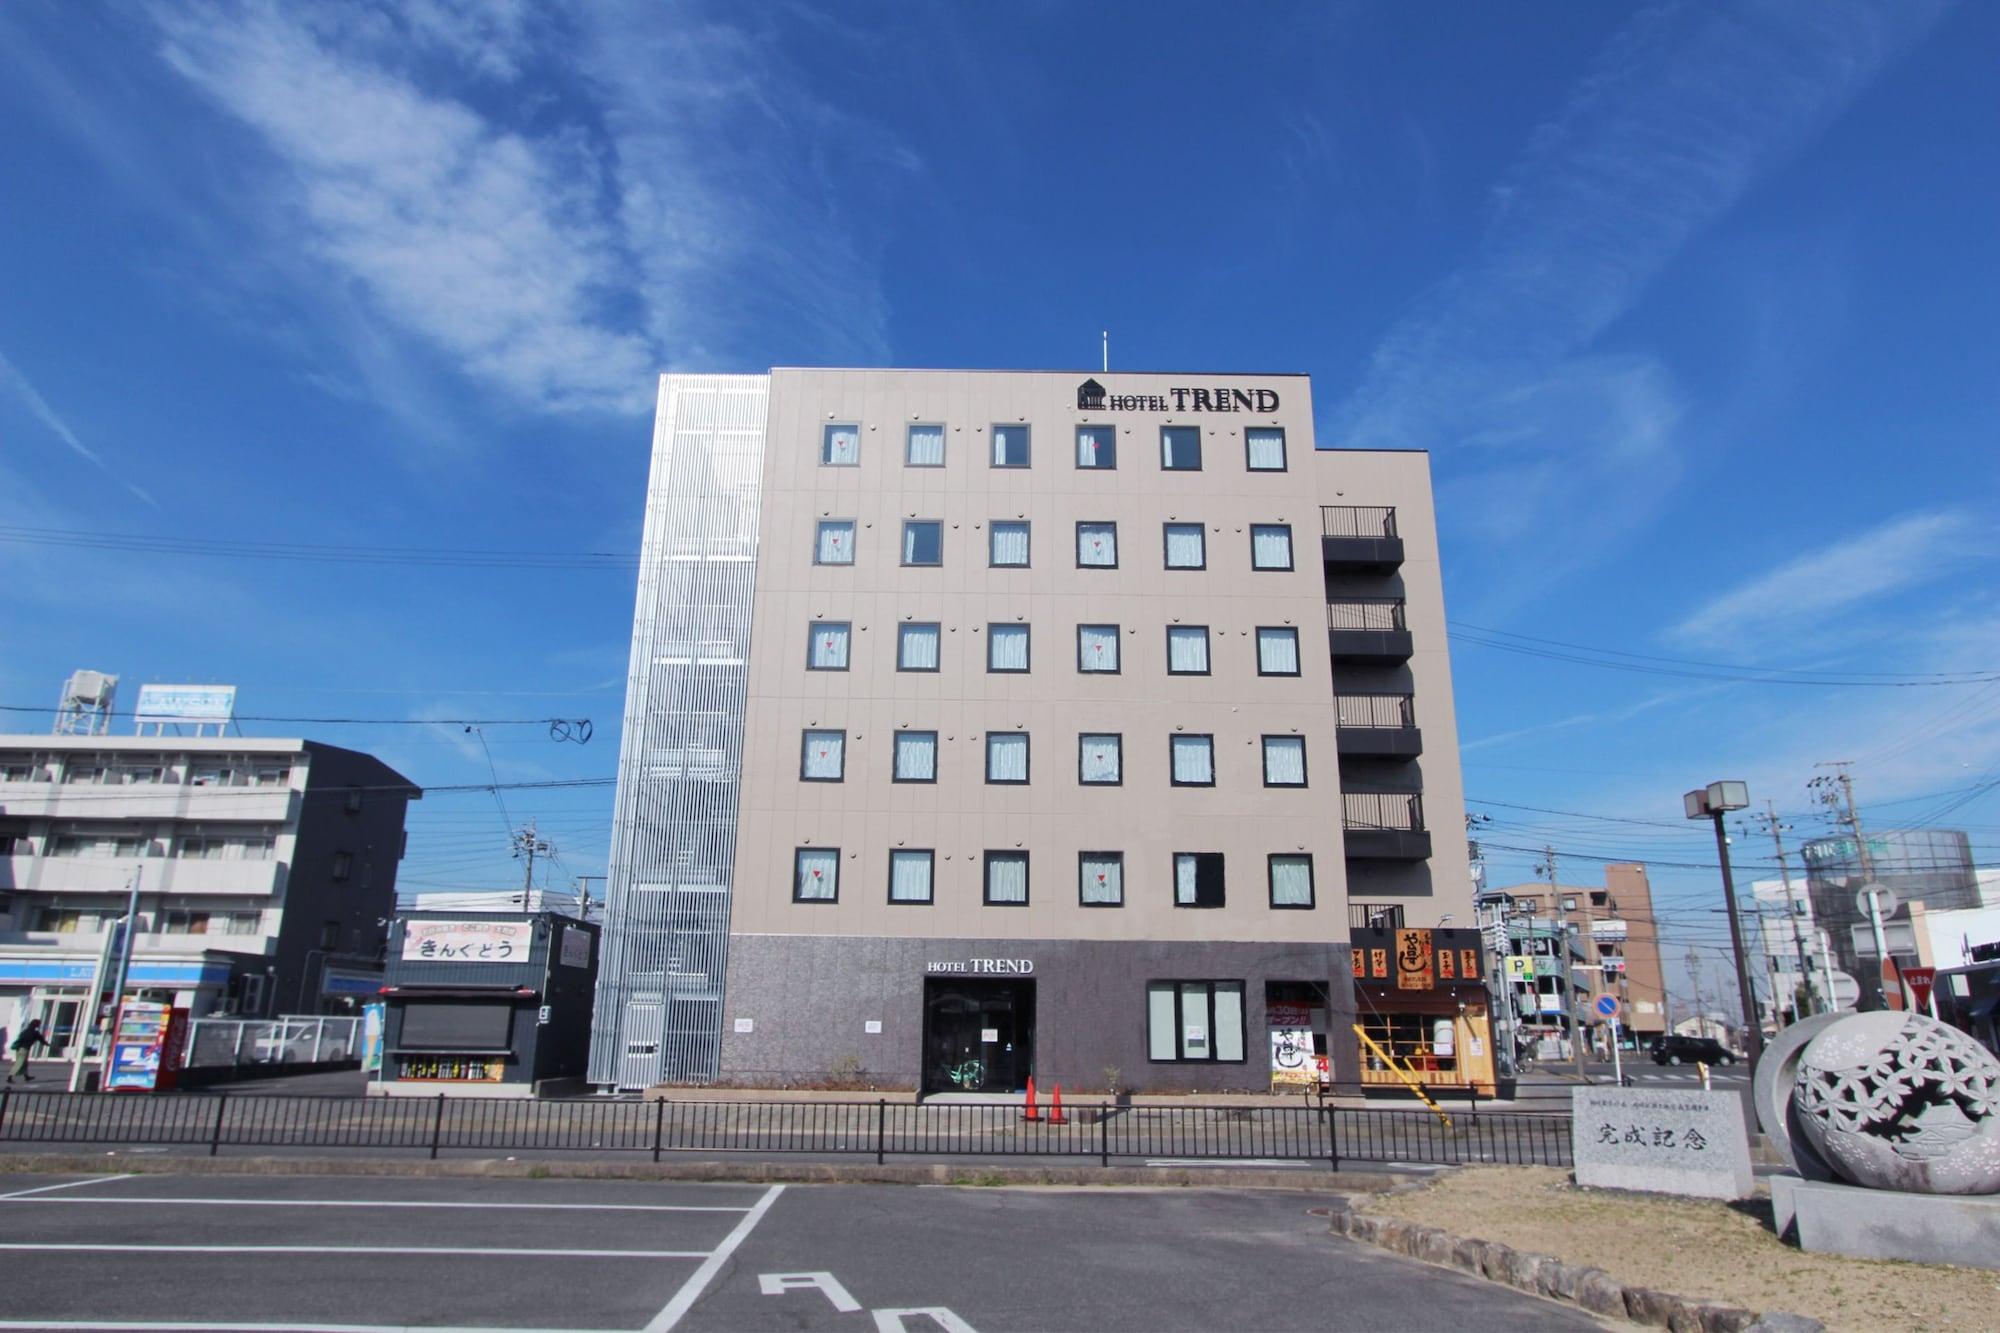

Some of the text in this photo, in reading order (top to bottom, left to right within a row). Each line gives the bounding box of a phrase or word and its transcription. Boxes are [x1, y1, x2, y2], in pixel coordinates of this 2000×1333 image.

[1109, 388, 1280, 412] HOTEL TREND
[420, 940, 513, 958] きんぐどう
[927, 959, 1034, 974] HOTEL TREND
[1514, 960, 1525, 972] P
[1597, 1123, 1708, 1150] 完成記念
